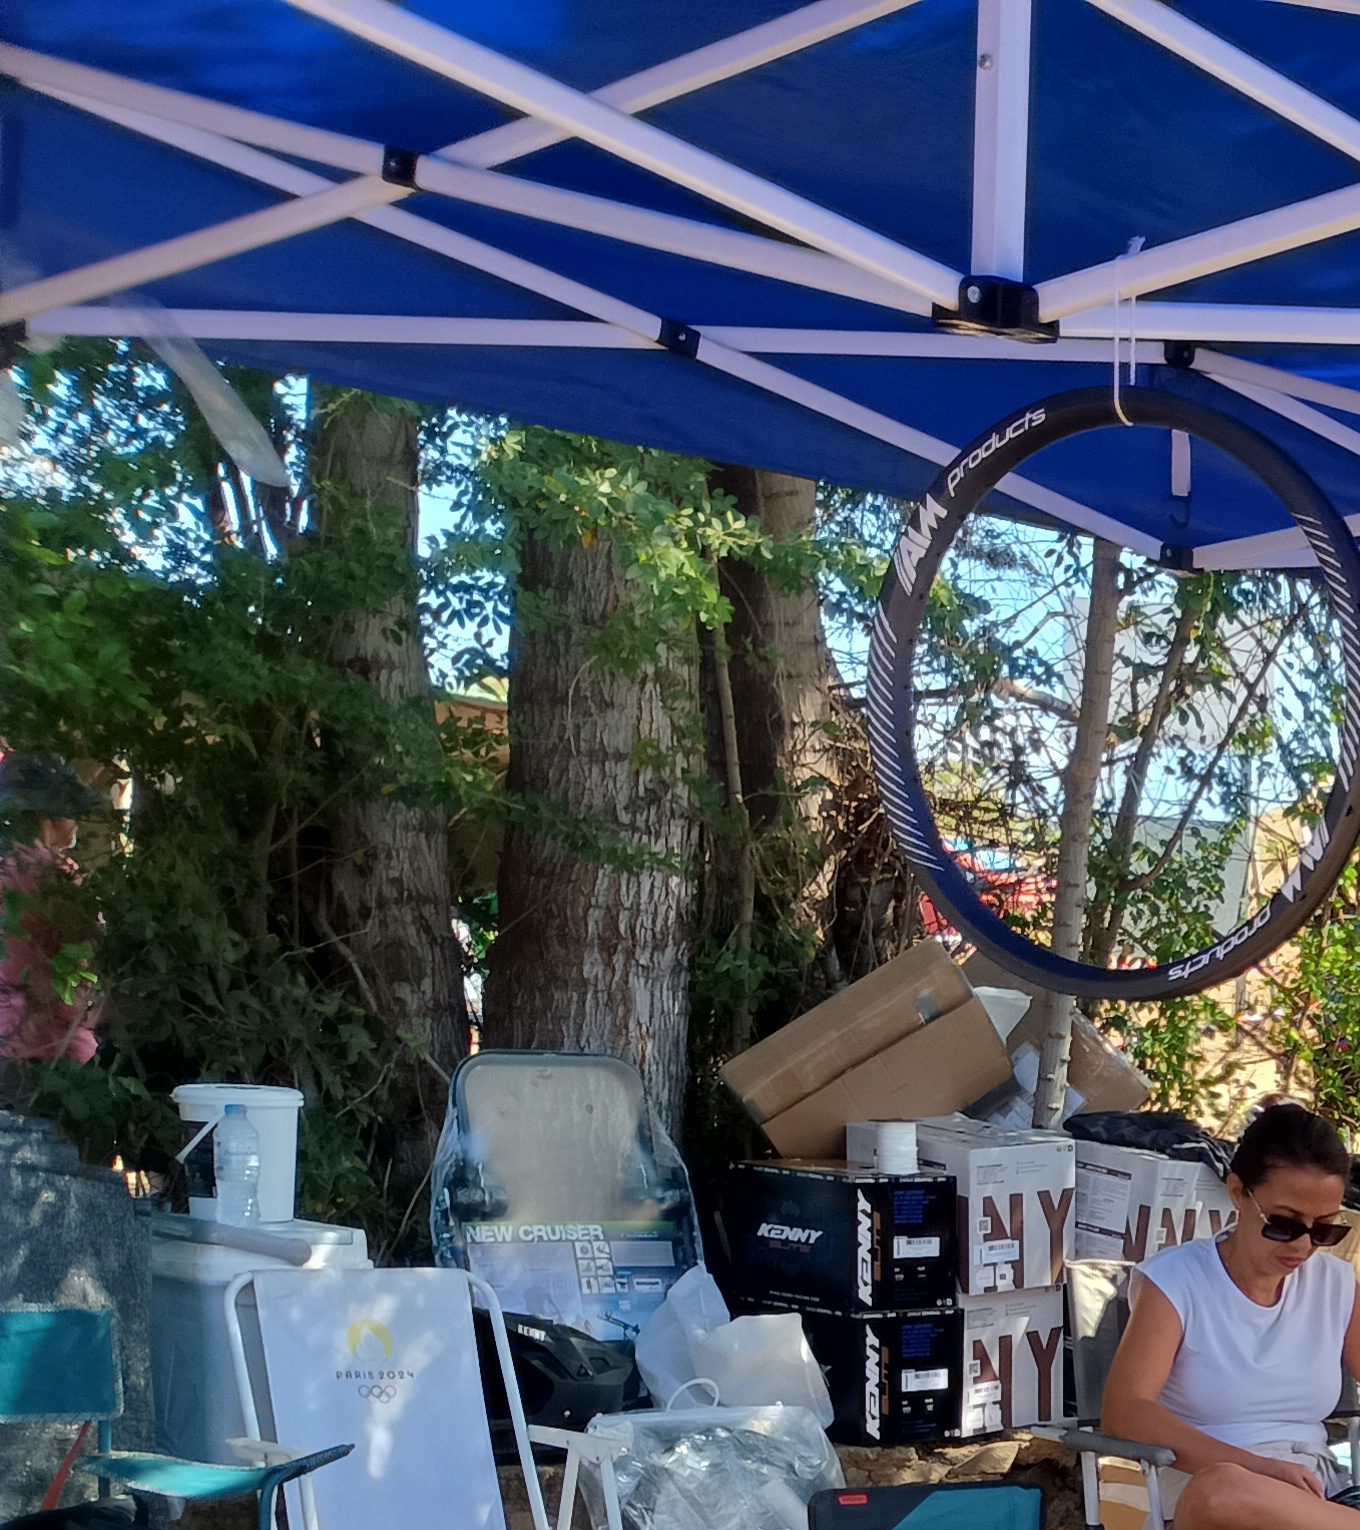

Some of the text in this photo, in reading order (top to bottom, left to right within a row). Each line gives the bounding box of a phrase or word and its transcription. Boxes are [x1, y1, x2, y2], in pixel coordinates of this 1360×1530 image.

[947, 408, 1046, 498] products
[1168, 899, 1272, 981] products
[466, 1224, 513, 1242] NEW
[518, 1223, 605, 1242] CRUISER
[757, 1222, 824, 1245] KENNY
[857, 1188, 873, 1307] KENNY
[335, 1370, 415, 1380] PARIS 2024
[865, 1323, 881, 1441] KENNY
